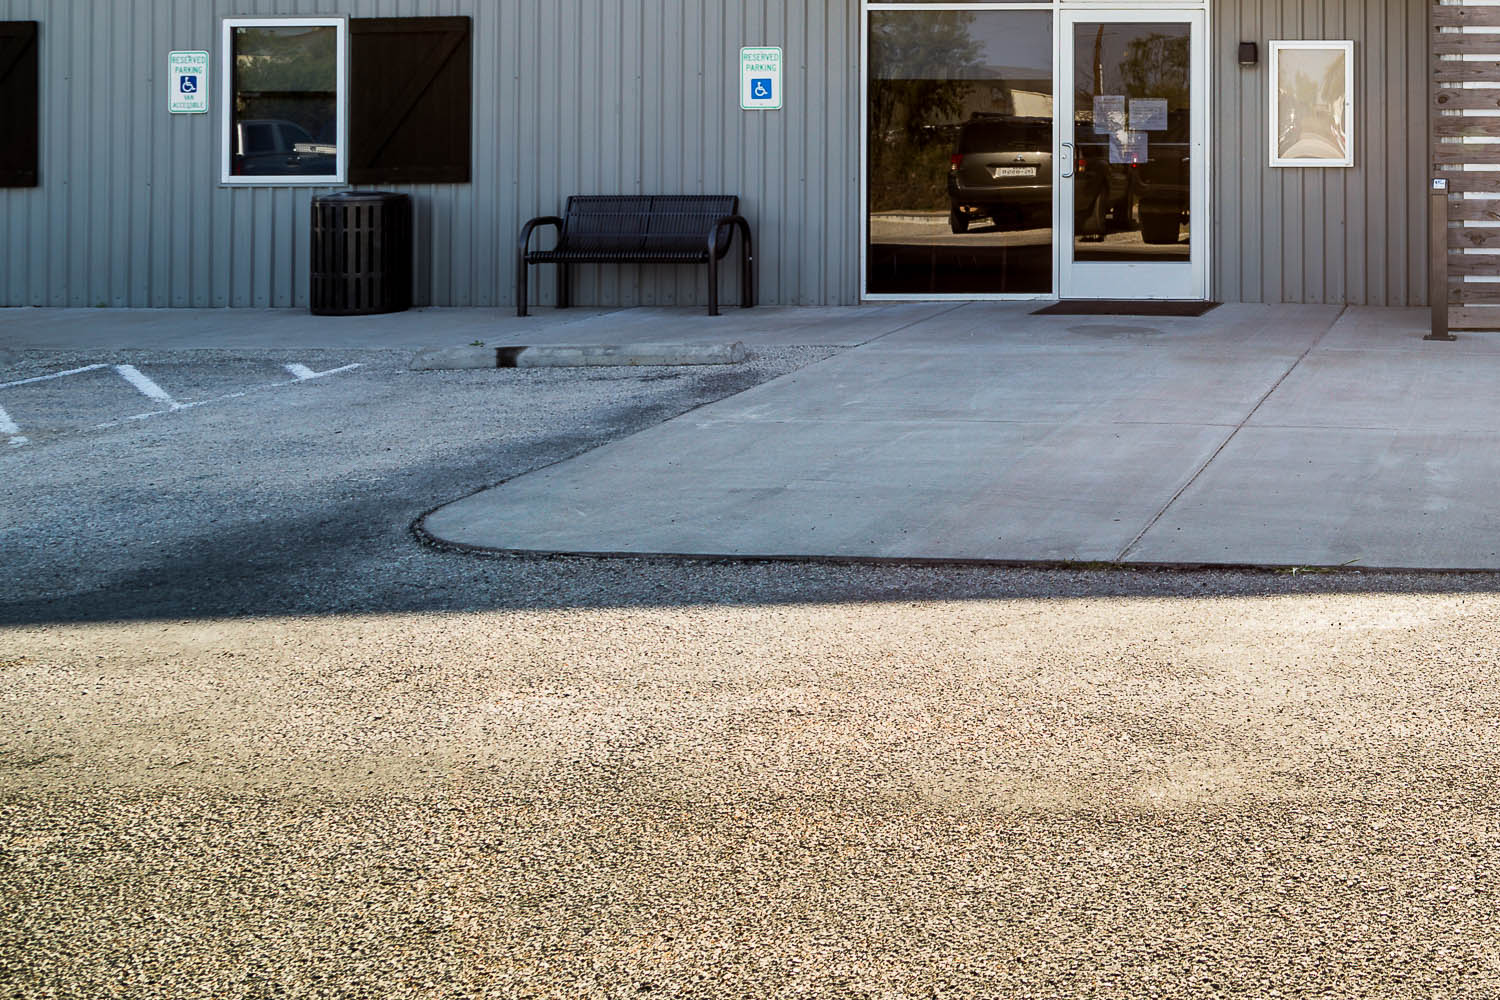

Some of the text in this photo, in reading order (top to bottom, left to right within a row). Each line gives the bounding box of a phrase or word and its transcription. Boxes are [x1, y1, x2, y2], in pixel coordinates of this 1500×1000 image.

[170, 56, 206, 64] RESERVED
[743, 53, 779, 61] RESERVED
[175, 66, 203, 74] PARKING
[745, 63, 777, 72] PARKING
